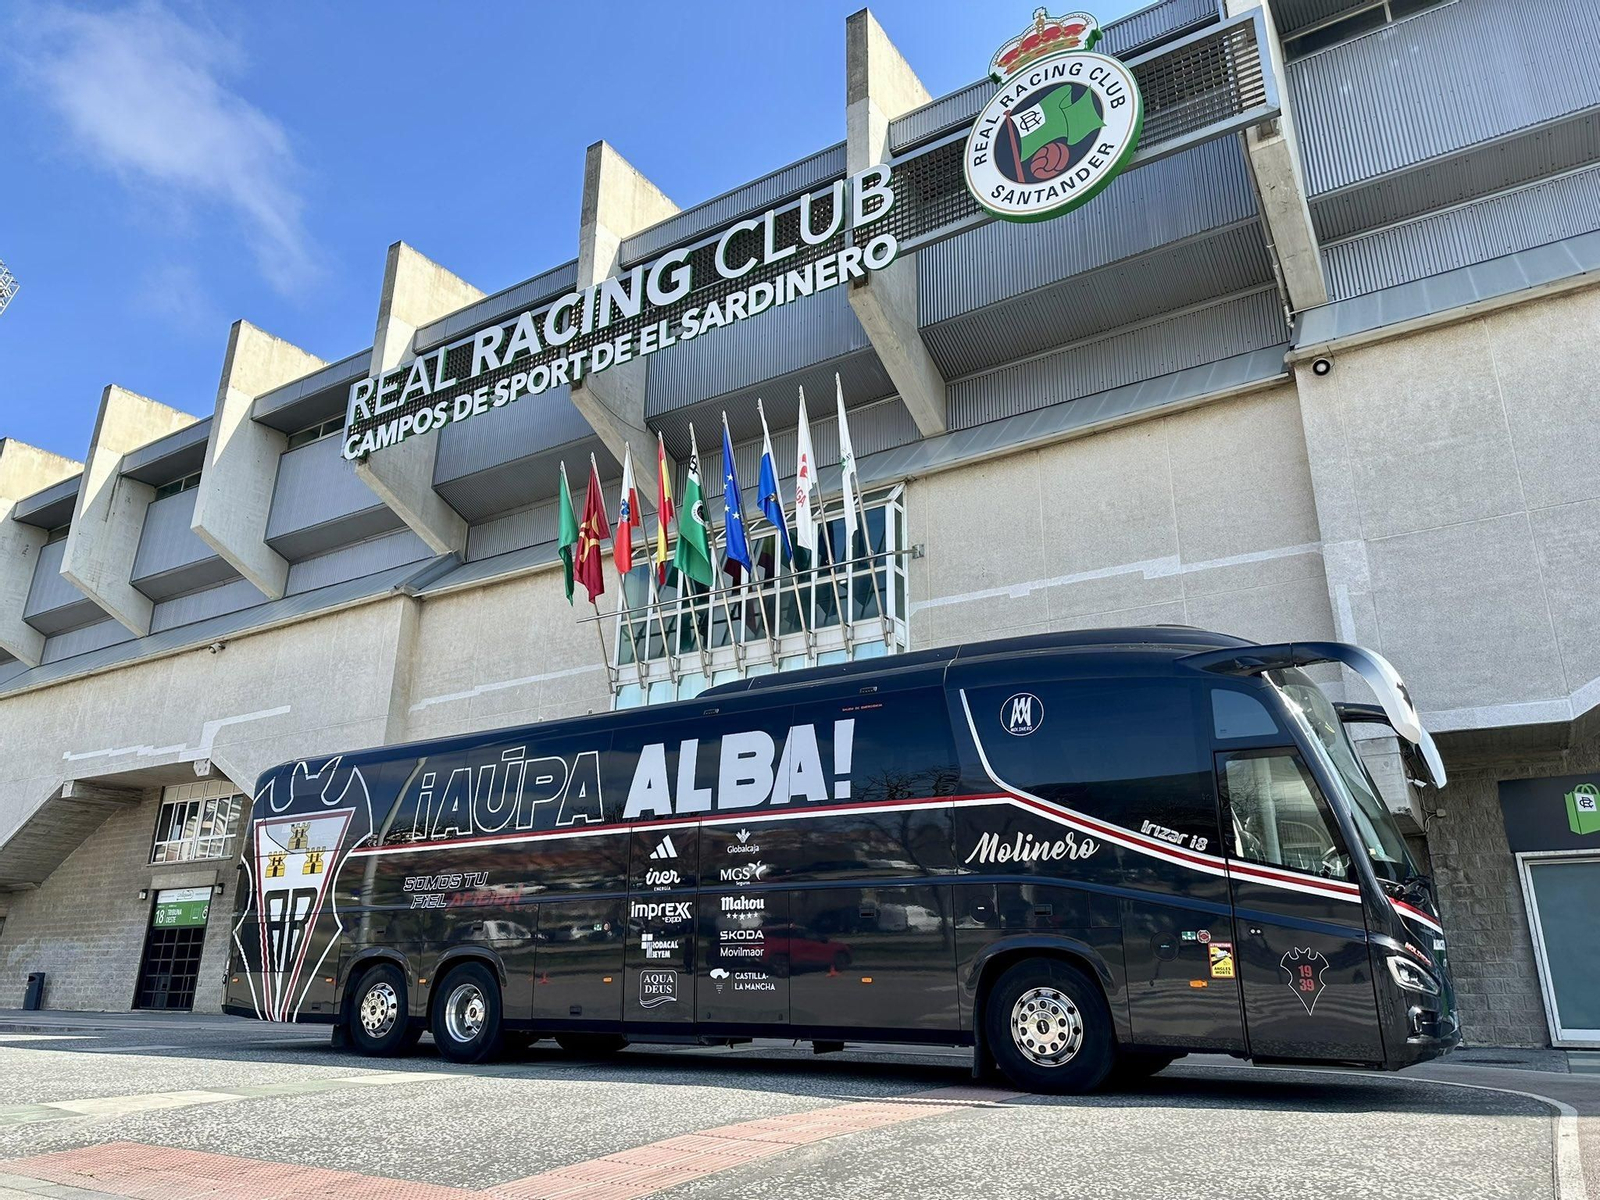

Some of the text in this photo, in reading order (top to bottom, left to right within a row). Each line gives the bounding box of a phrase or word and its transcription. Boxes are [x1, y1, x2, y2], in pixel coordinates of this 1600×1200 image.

[974, 62, 1126, 167] REAL RACING CLUB
[991, 142, 1115, 205] SANTANDER
[348, 163, 896, 427] REAL RACING CLUB
[344, 233, 899, 460] CAMPOS DE SPORT DE EL SARDINERO
[622, 718, 855, 819] ALBA!
[1140, 819, 1208, 851] Irizar i8
[727, 844, 760, 855] Globalcaja
[964, 831, 1100, 864] Molinero
[403, 871, 489, 892] SOMOS TU
[720, 867, 751, 881] MGS
[410, 893, 447, 909] FIEL
[720, 895, 765, 911] Mahou
[155, 909, 165, 924] 18
[720, 946, 764, 957] Movilmaor
[1298, 964, 1313, 978] 19
[643, 974, 674, 985] AQUA
[745, 983, 776, 991] MANCHA
[1299, 978, 1315, 992] 39
[644, 984, 673, 994] DEUS
